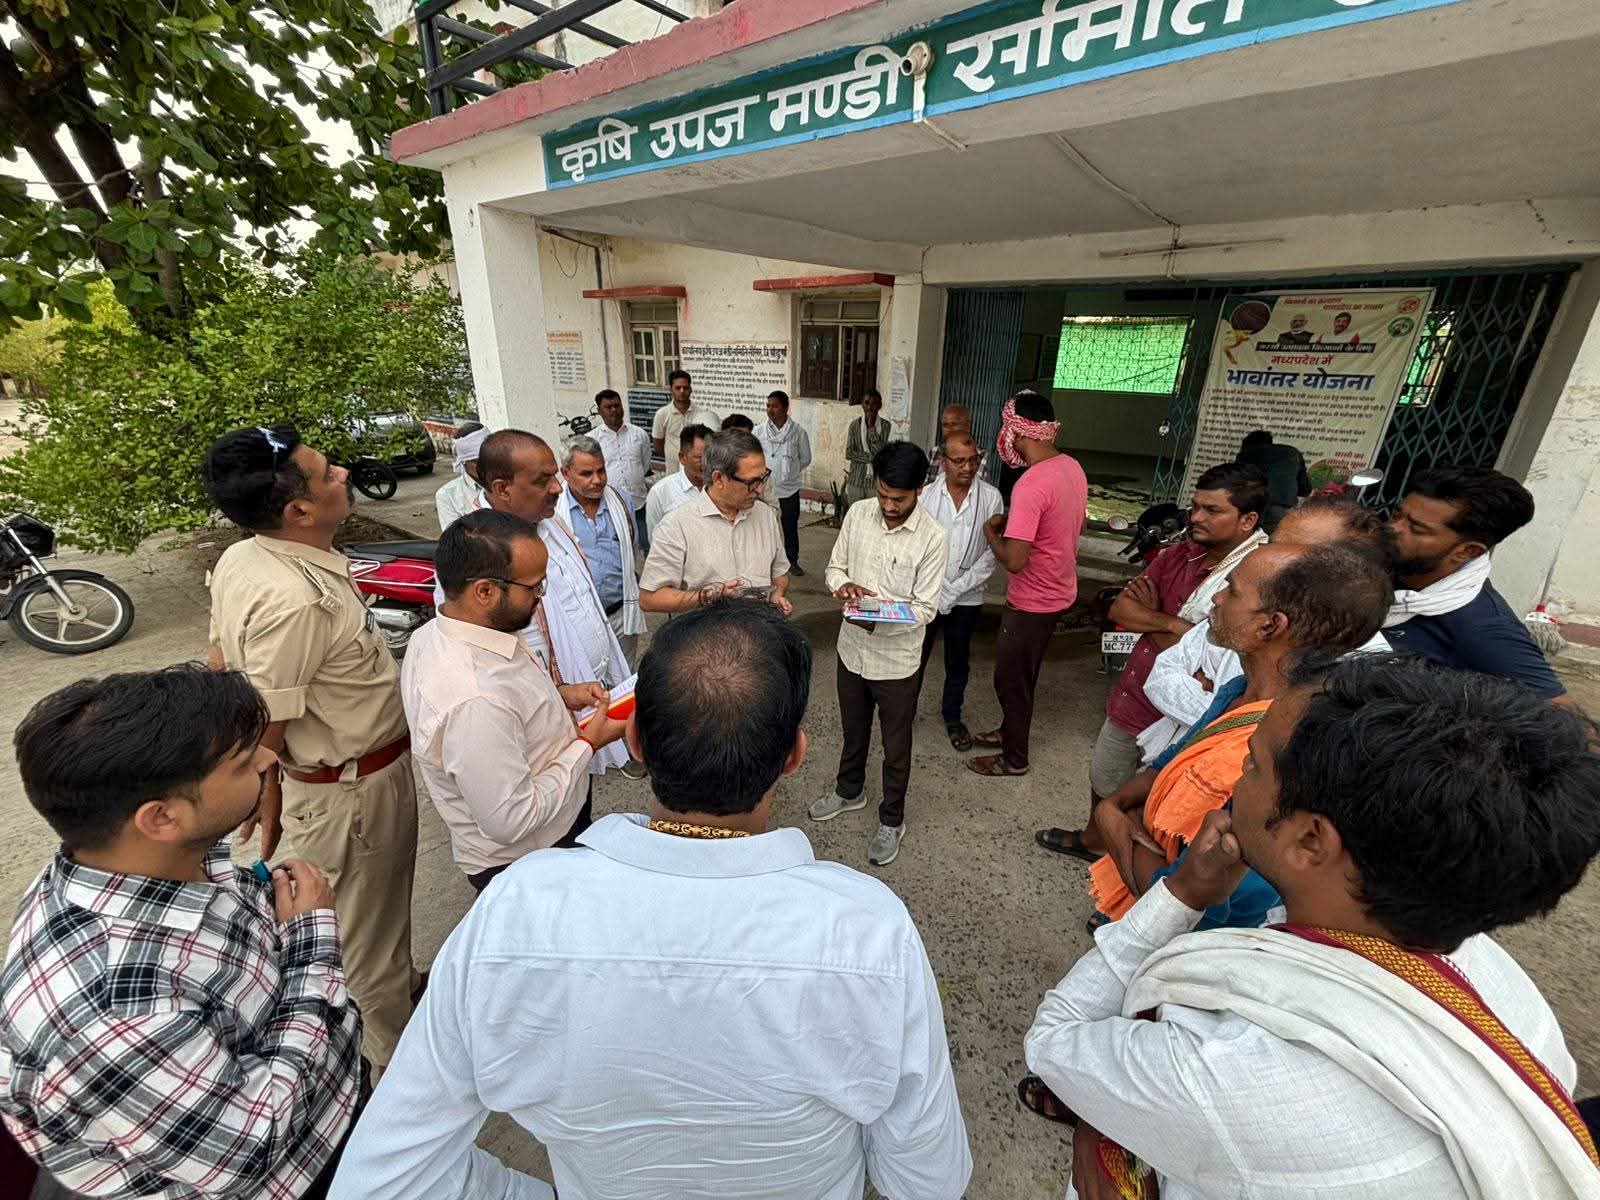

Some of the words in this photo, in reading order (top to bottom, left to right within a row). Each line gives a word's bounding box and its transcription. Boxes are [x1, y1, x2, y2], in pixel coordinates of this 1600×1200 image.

[555, 117, 639, 183] कृषि
[649, 95, 761, 160] उपज
[766, 44, 902, 132] मण्डी
[1270, 354, 1319, 366] मध्यप्रदेश
[1321, 353, 1335, 366] में
[1227, 366, 1299, 388] भावांतर
[1302, 367, 1376, 391] योजना
